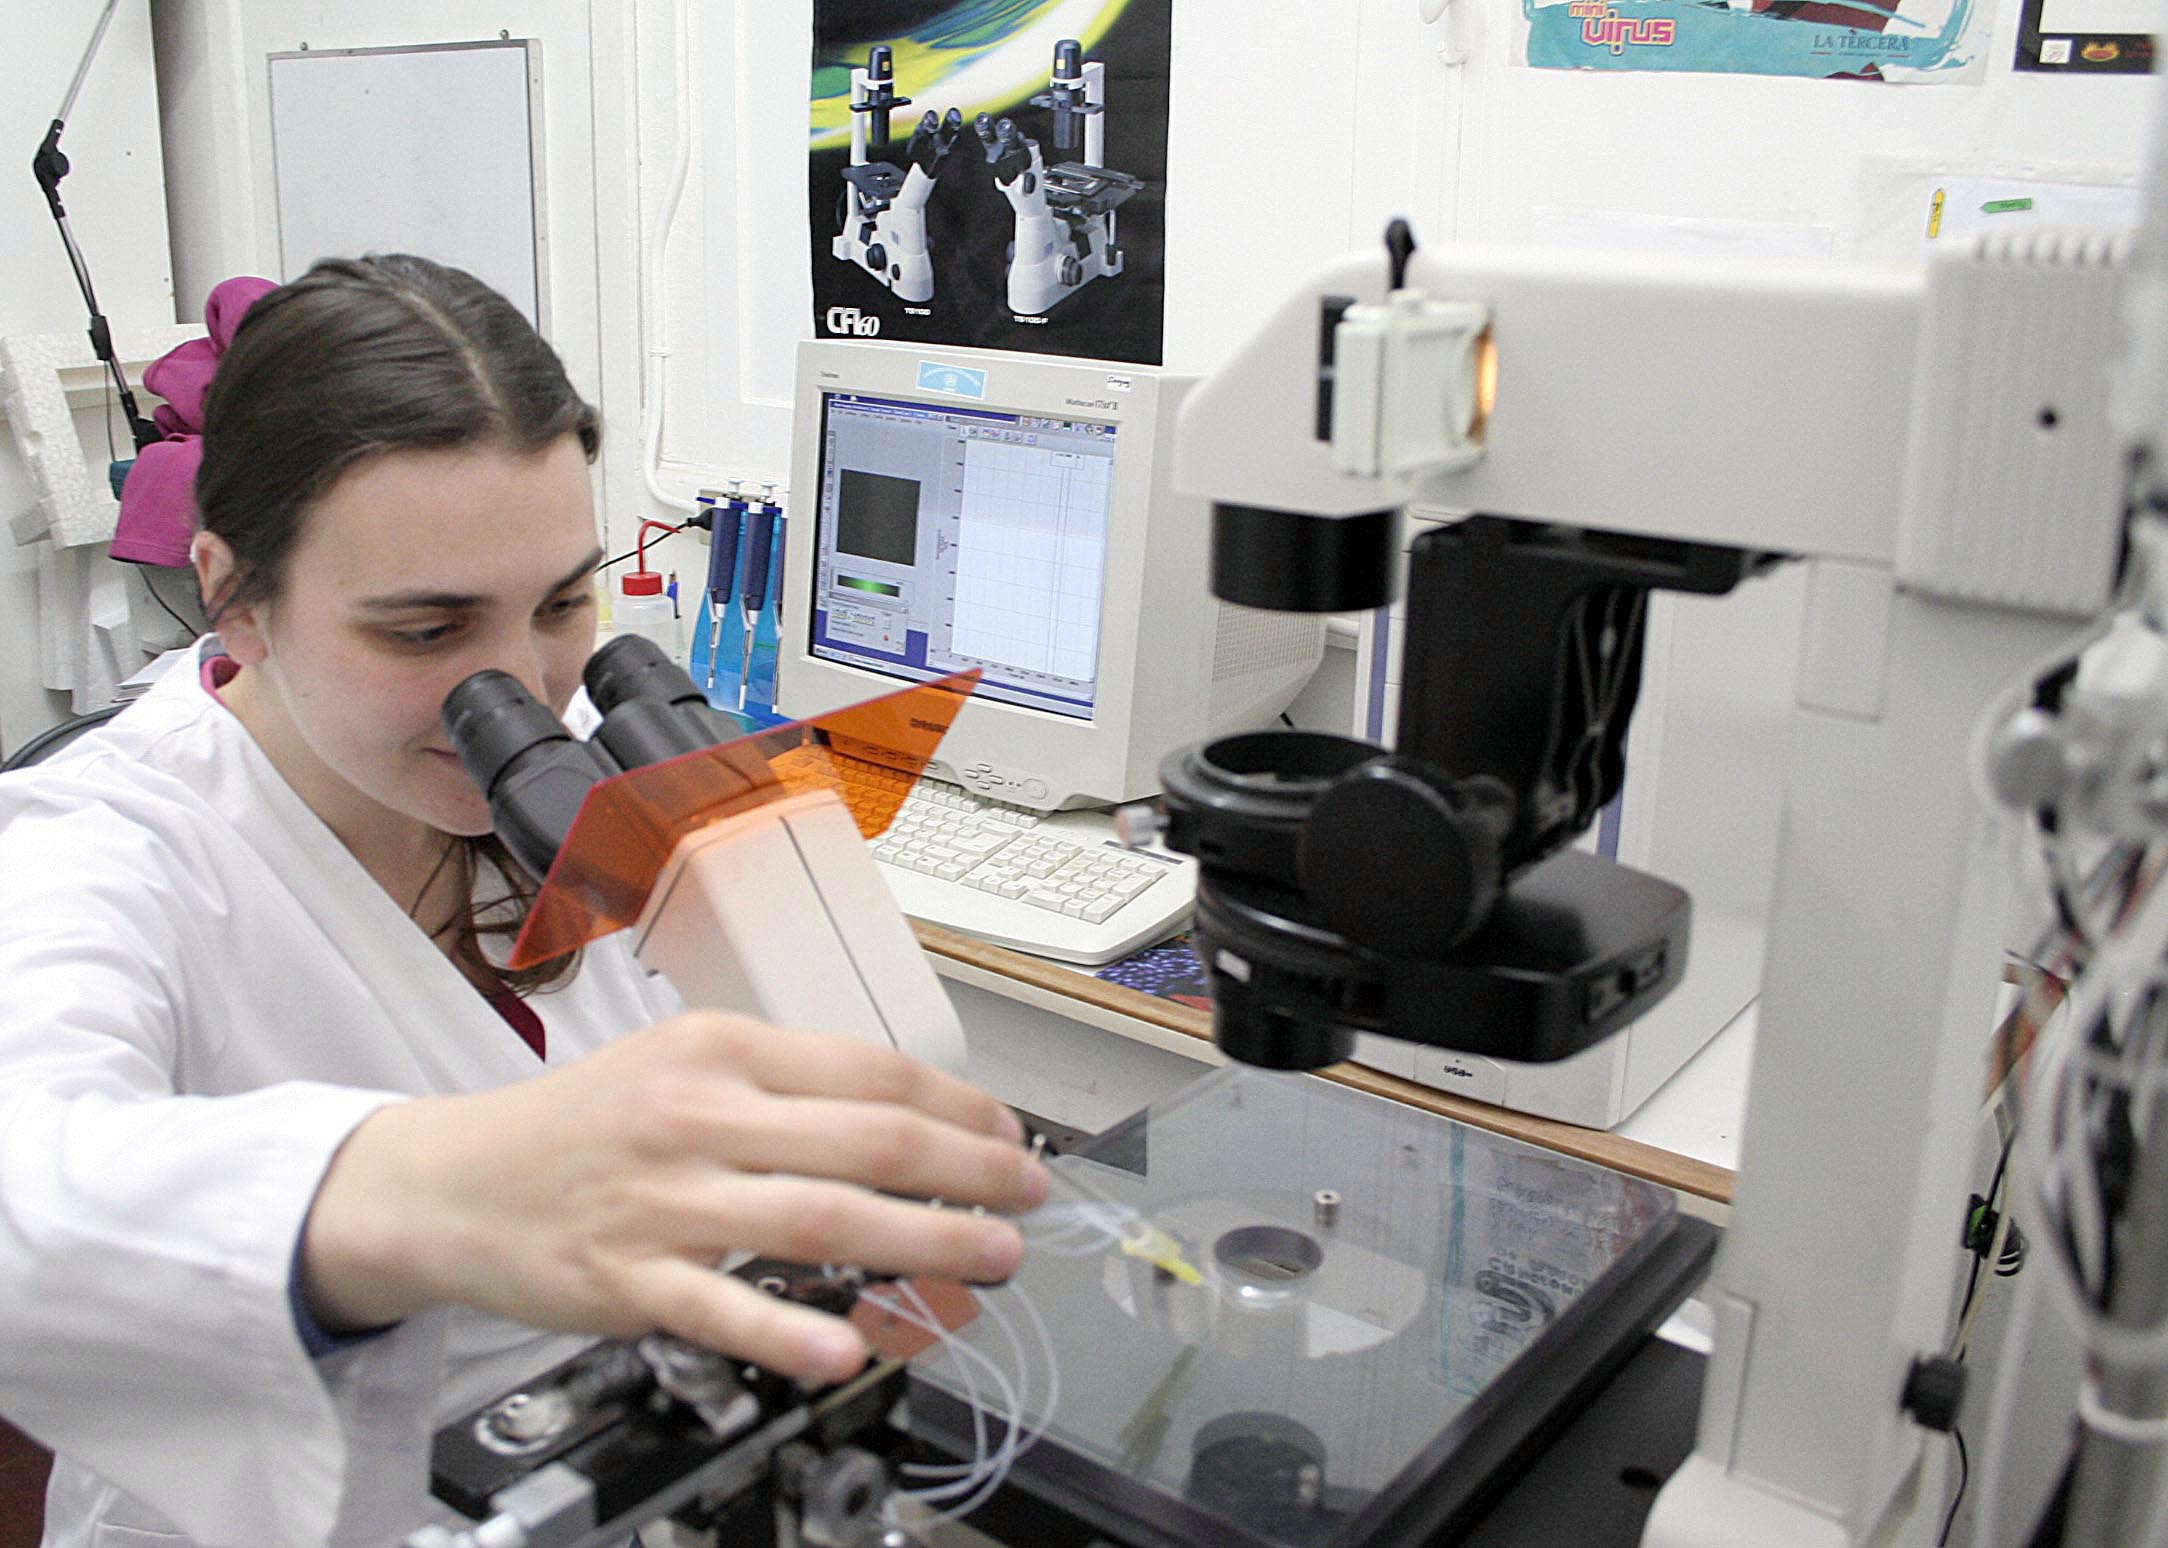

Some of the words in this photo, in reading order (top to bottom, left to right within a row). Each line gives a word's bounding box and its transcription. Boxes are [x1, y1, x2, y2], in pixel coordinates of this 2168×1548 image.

[1581, 8, 1677, 54] virus
[1814, 34, 1833, 48] LA
[1839, 35, 1910, 50] TERCERA
